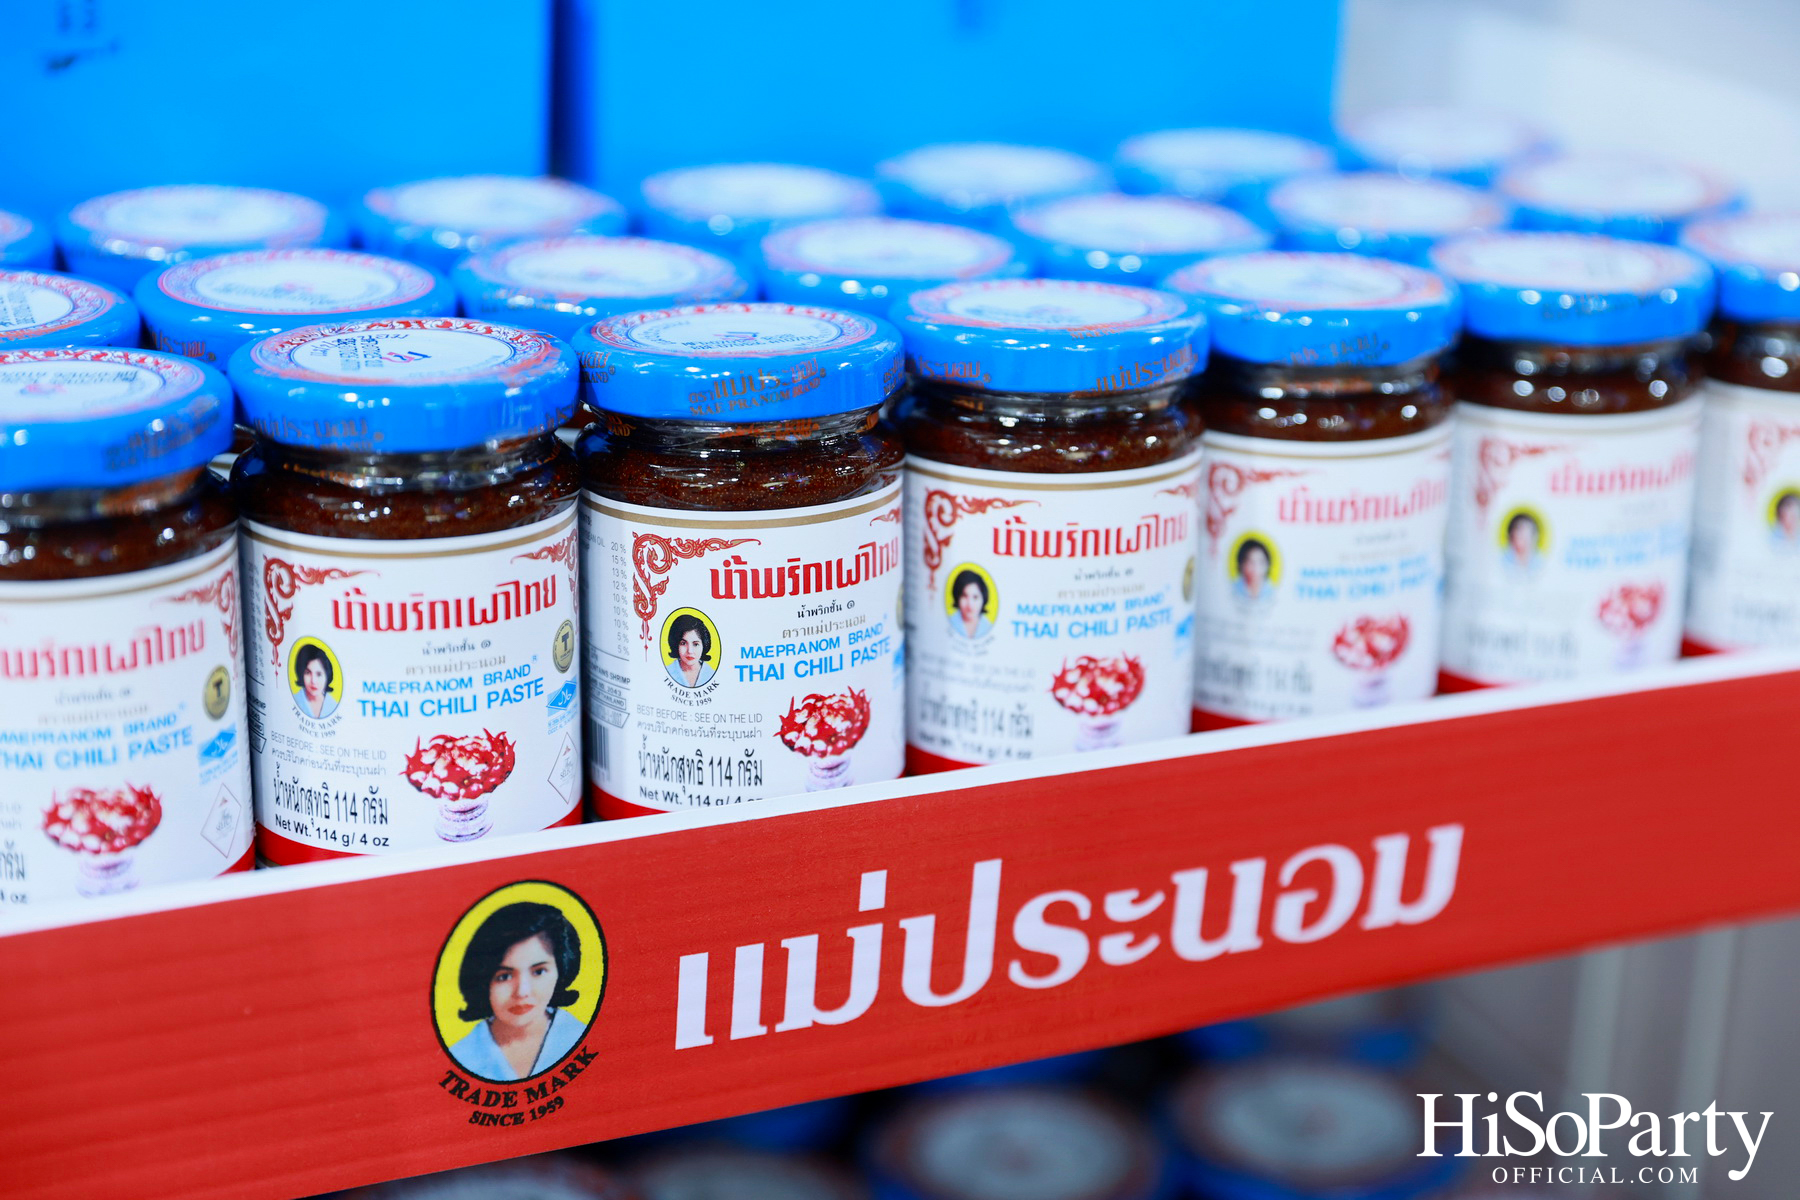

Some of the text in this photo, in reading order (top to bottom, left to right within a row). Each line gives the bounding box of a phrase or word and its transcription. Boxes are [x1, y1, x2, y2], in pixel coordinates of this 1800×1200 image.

[710, 536, 899, 599] น้ำพริกเผาไทย
[331, 574, 556, 632] น้ำพริกเผาไทย
[797, 599, 842, 618] น้ำพริกชั้น
[782, 614, 866, 639] ตราแม่ประนอม
[1011, 607, 1172, 638] THAI CHILI PASTE
[0, 619, 205, 678] พริกเผาไทย
[740, 622, 883, 659] MAEPRANOM BRAND
[734, 663, 785, 682] THAI
[794, 654, 843, 678] CHILI
[851, 636, 891, 667] PASTE
[362, 677, 473, 695] MAEPRANOM
[483, 664, 531, 686] BRAND
[663, 676, 720, 699] TRADE MARK
[357, 677, 544, 718] THAI CHILI PASTE
[671, 694, 712, 707] SINCE 1959
[123, 712, 177, 736] BRAND
[292, 706, 342, 730] TRADE MARK
[636, 704, 654, 717] BEST
[656, 708, 687, 721] BEFORE
[695, 712, 710, 723] SEE
[713, 714, 727, 723] ON
[729, 714, 746, 723] THE
[748, 713, 762, 723] LID
[271, 731, 386, 760] BEST BEFORE SEE ON THE LID
[299, 723, 319, 738] SINCE
[54, 745, 118, 770] CHILI
[128, 725, 193, 760] PASTE
[708, 756, 733, 787] 114
[738, 748, 763, 787] กรัม
[334, 790, 358, 823] 114
[362, 785, 388, 825] กรัม
[639, 786, 658, 801] Net
[662, 790, 682, 805] Wt.
[688, 794, 711, 807] 114
[275, 814, 291, 831] Net
[293, 820, 312, 837] Wt.
[316, 826, 337, 842] 114
[360, 833, 368, 845] 4
[373, 837, 389, 847] oz
[674, 823, 1465, 1050] แม่ประนอม
[439, 1045, 599, 1108] TRADE MARK
[469, 1096, 565, 1127] SINCE 1959
